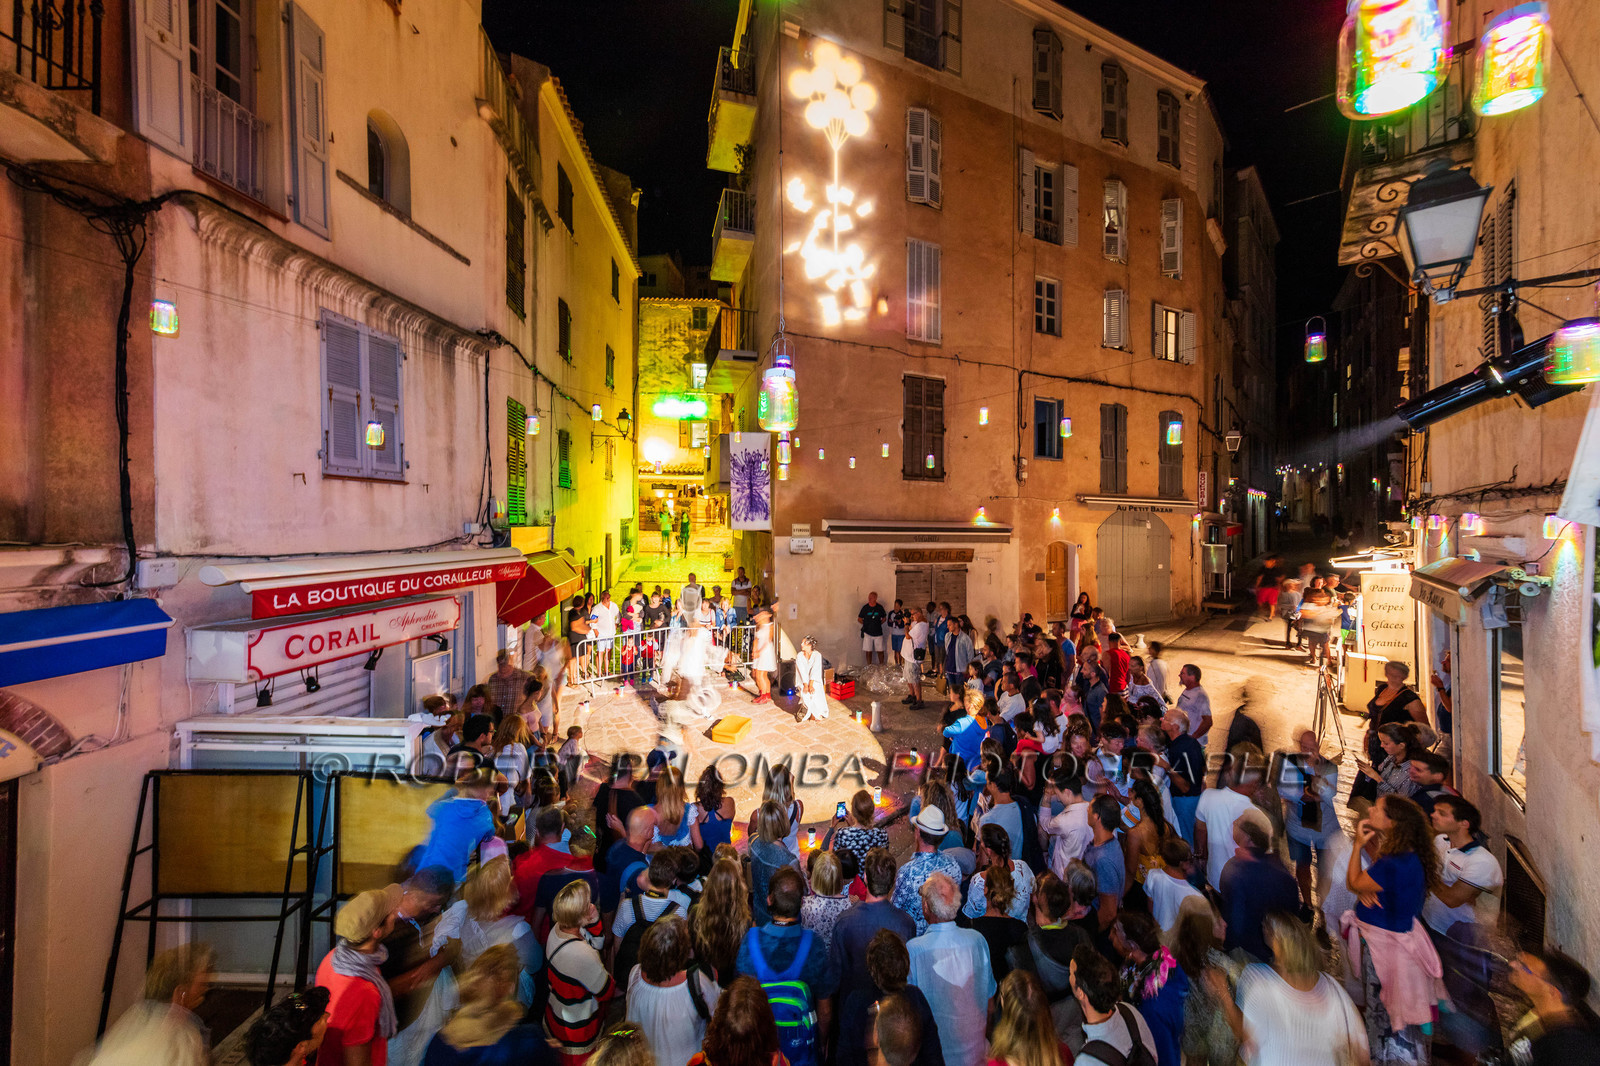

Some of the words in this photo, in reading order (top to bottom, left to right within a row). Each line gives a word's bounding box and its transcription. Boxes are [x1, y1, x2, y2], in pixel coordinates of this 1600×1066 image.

[903, 551, 967, 561] VOLUBILIS
[273, 592, 302, 609] LA
[307, 581, 396, 604] BOUTIQUE
[400, 576, 420, 592] DU
[423, 569, 493, 588] CORAILLEUR
[1369, 584, 1405, 593] Panini
[1370, 602, 1405, 613] Crêpes
[389, 608, 439, 632] Aphrodite
[1370, 620, 1405, 631] Glaces
[284, 623, 381, 660] CORAIL
[1367, 639, 1408, 649] Granita
